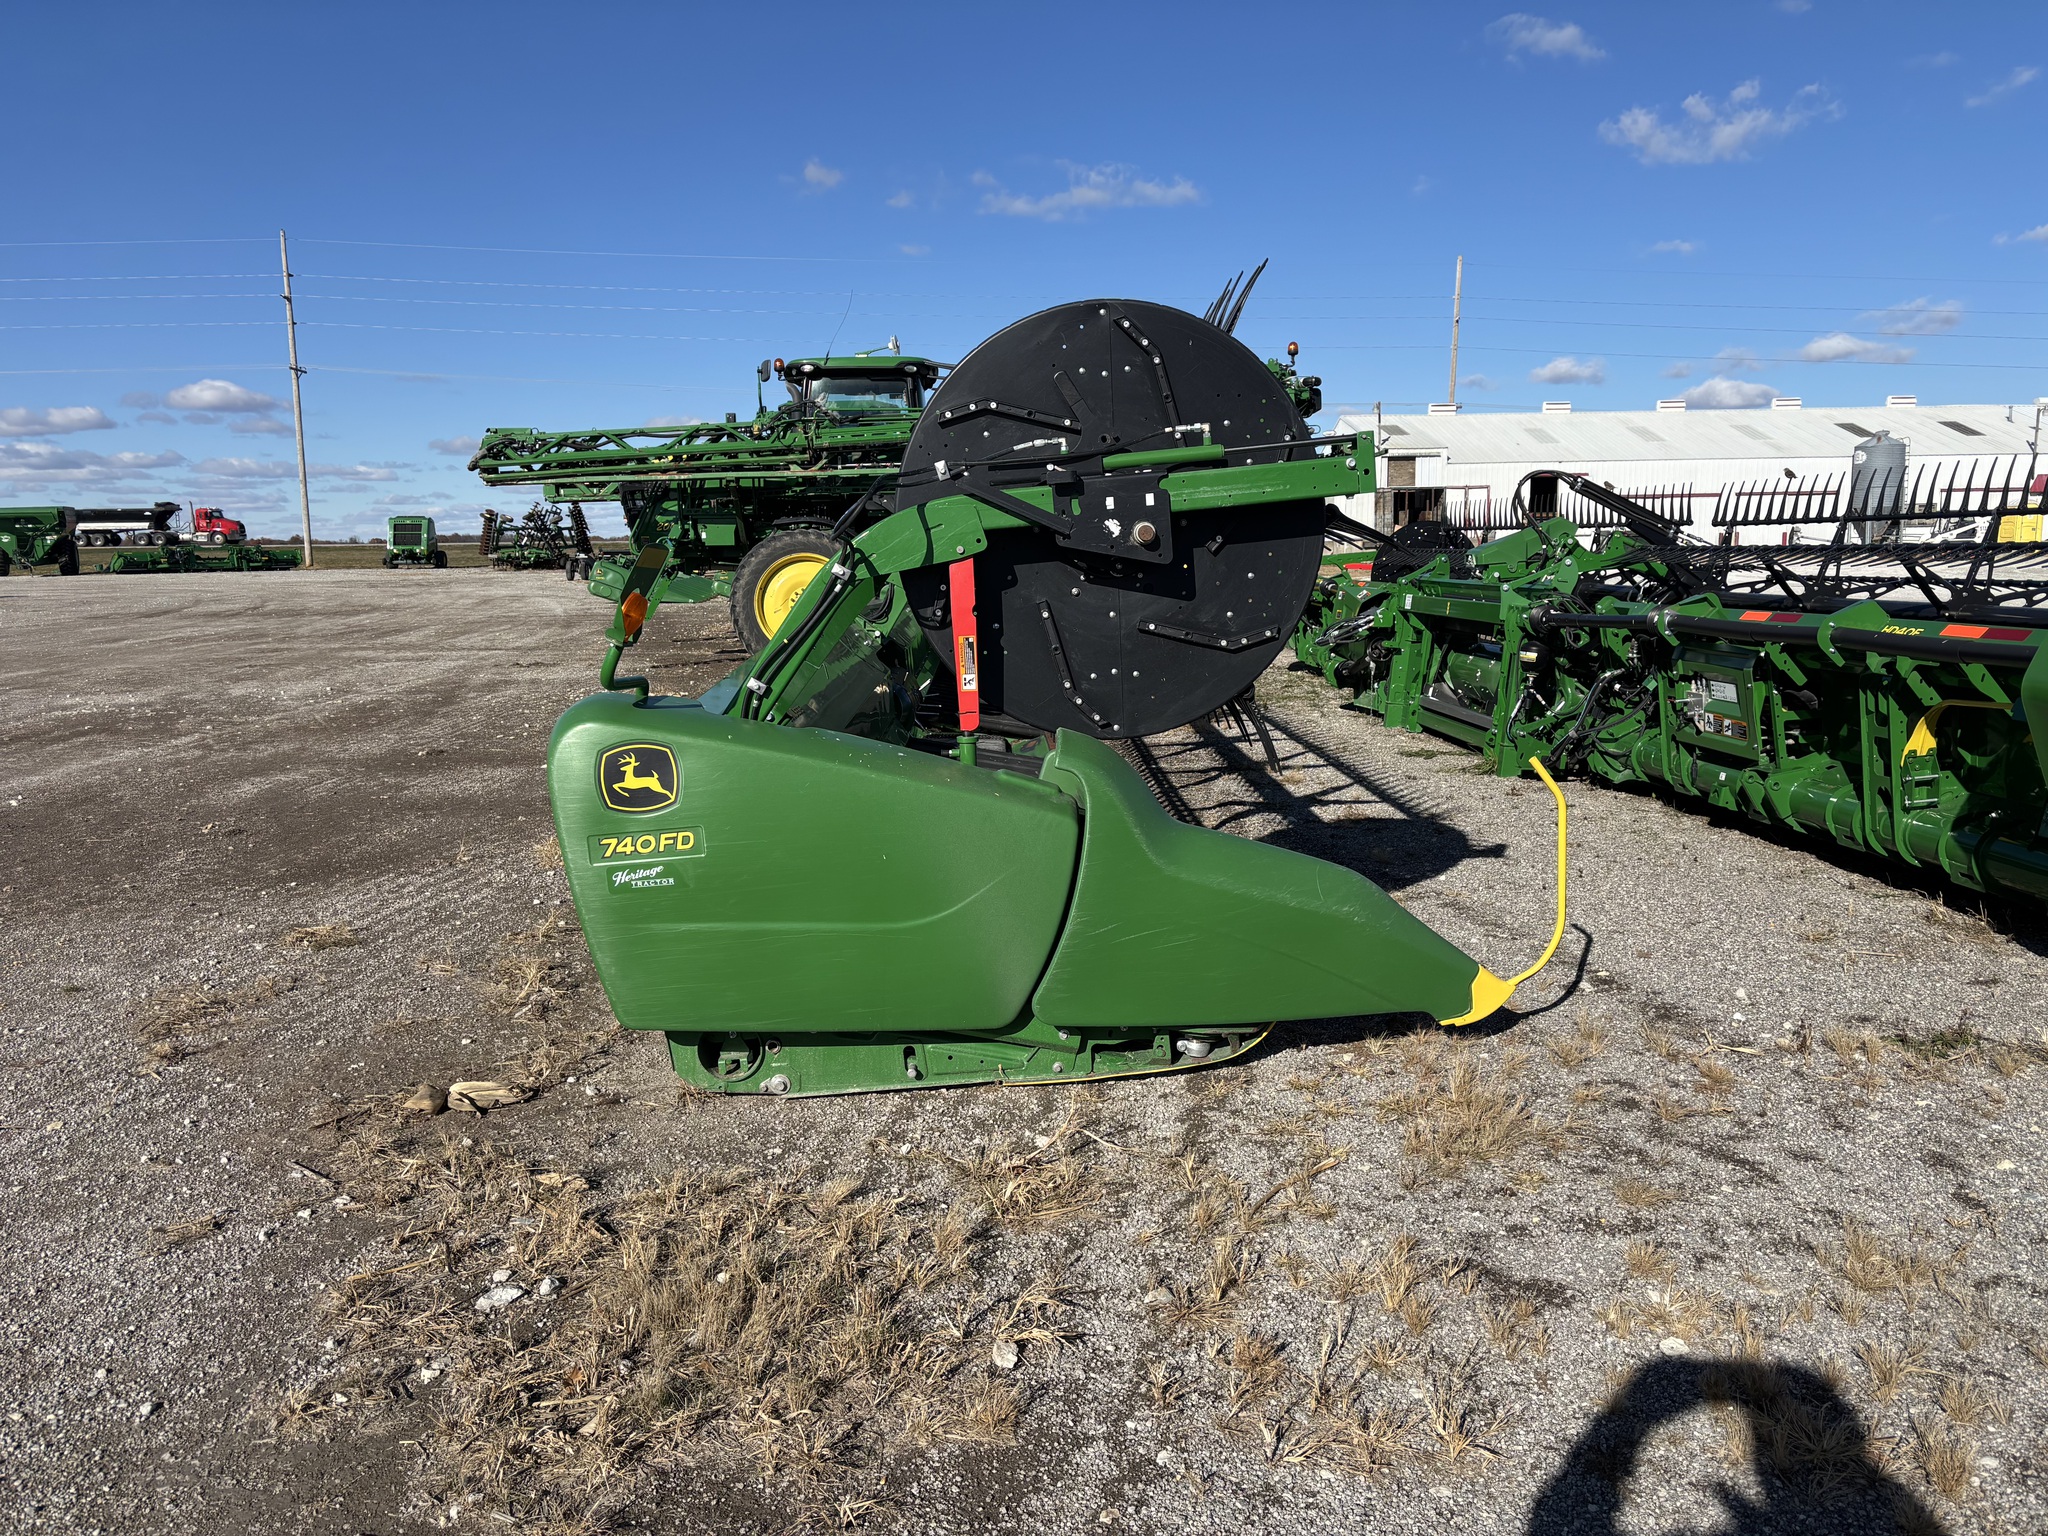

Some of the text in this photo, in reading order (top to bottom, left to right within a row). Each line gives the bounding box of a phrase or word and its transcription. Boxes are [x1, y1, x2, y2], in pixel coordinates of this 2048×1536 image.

[598, 831, 695, 859] 740FD
[612, 865, 664, 887] Heritage
[631, 877, 675, 888] TRACTOR
